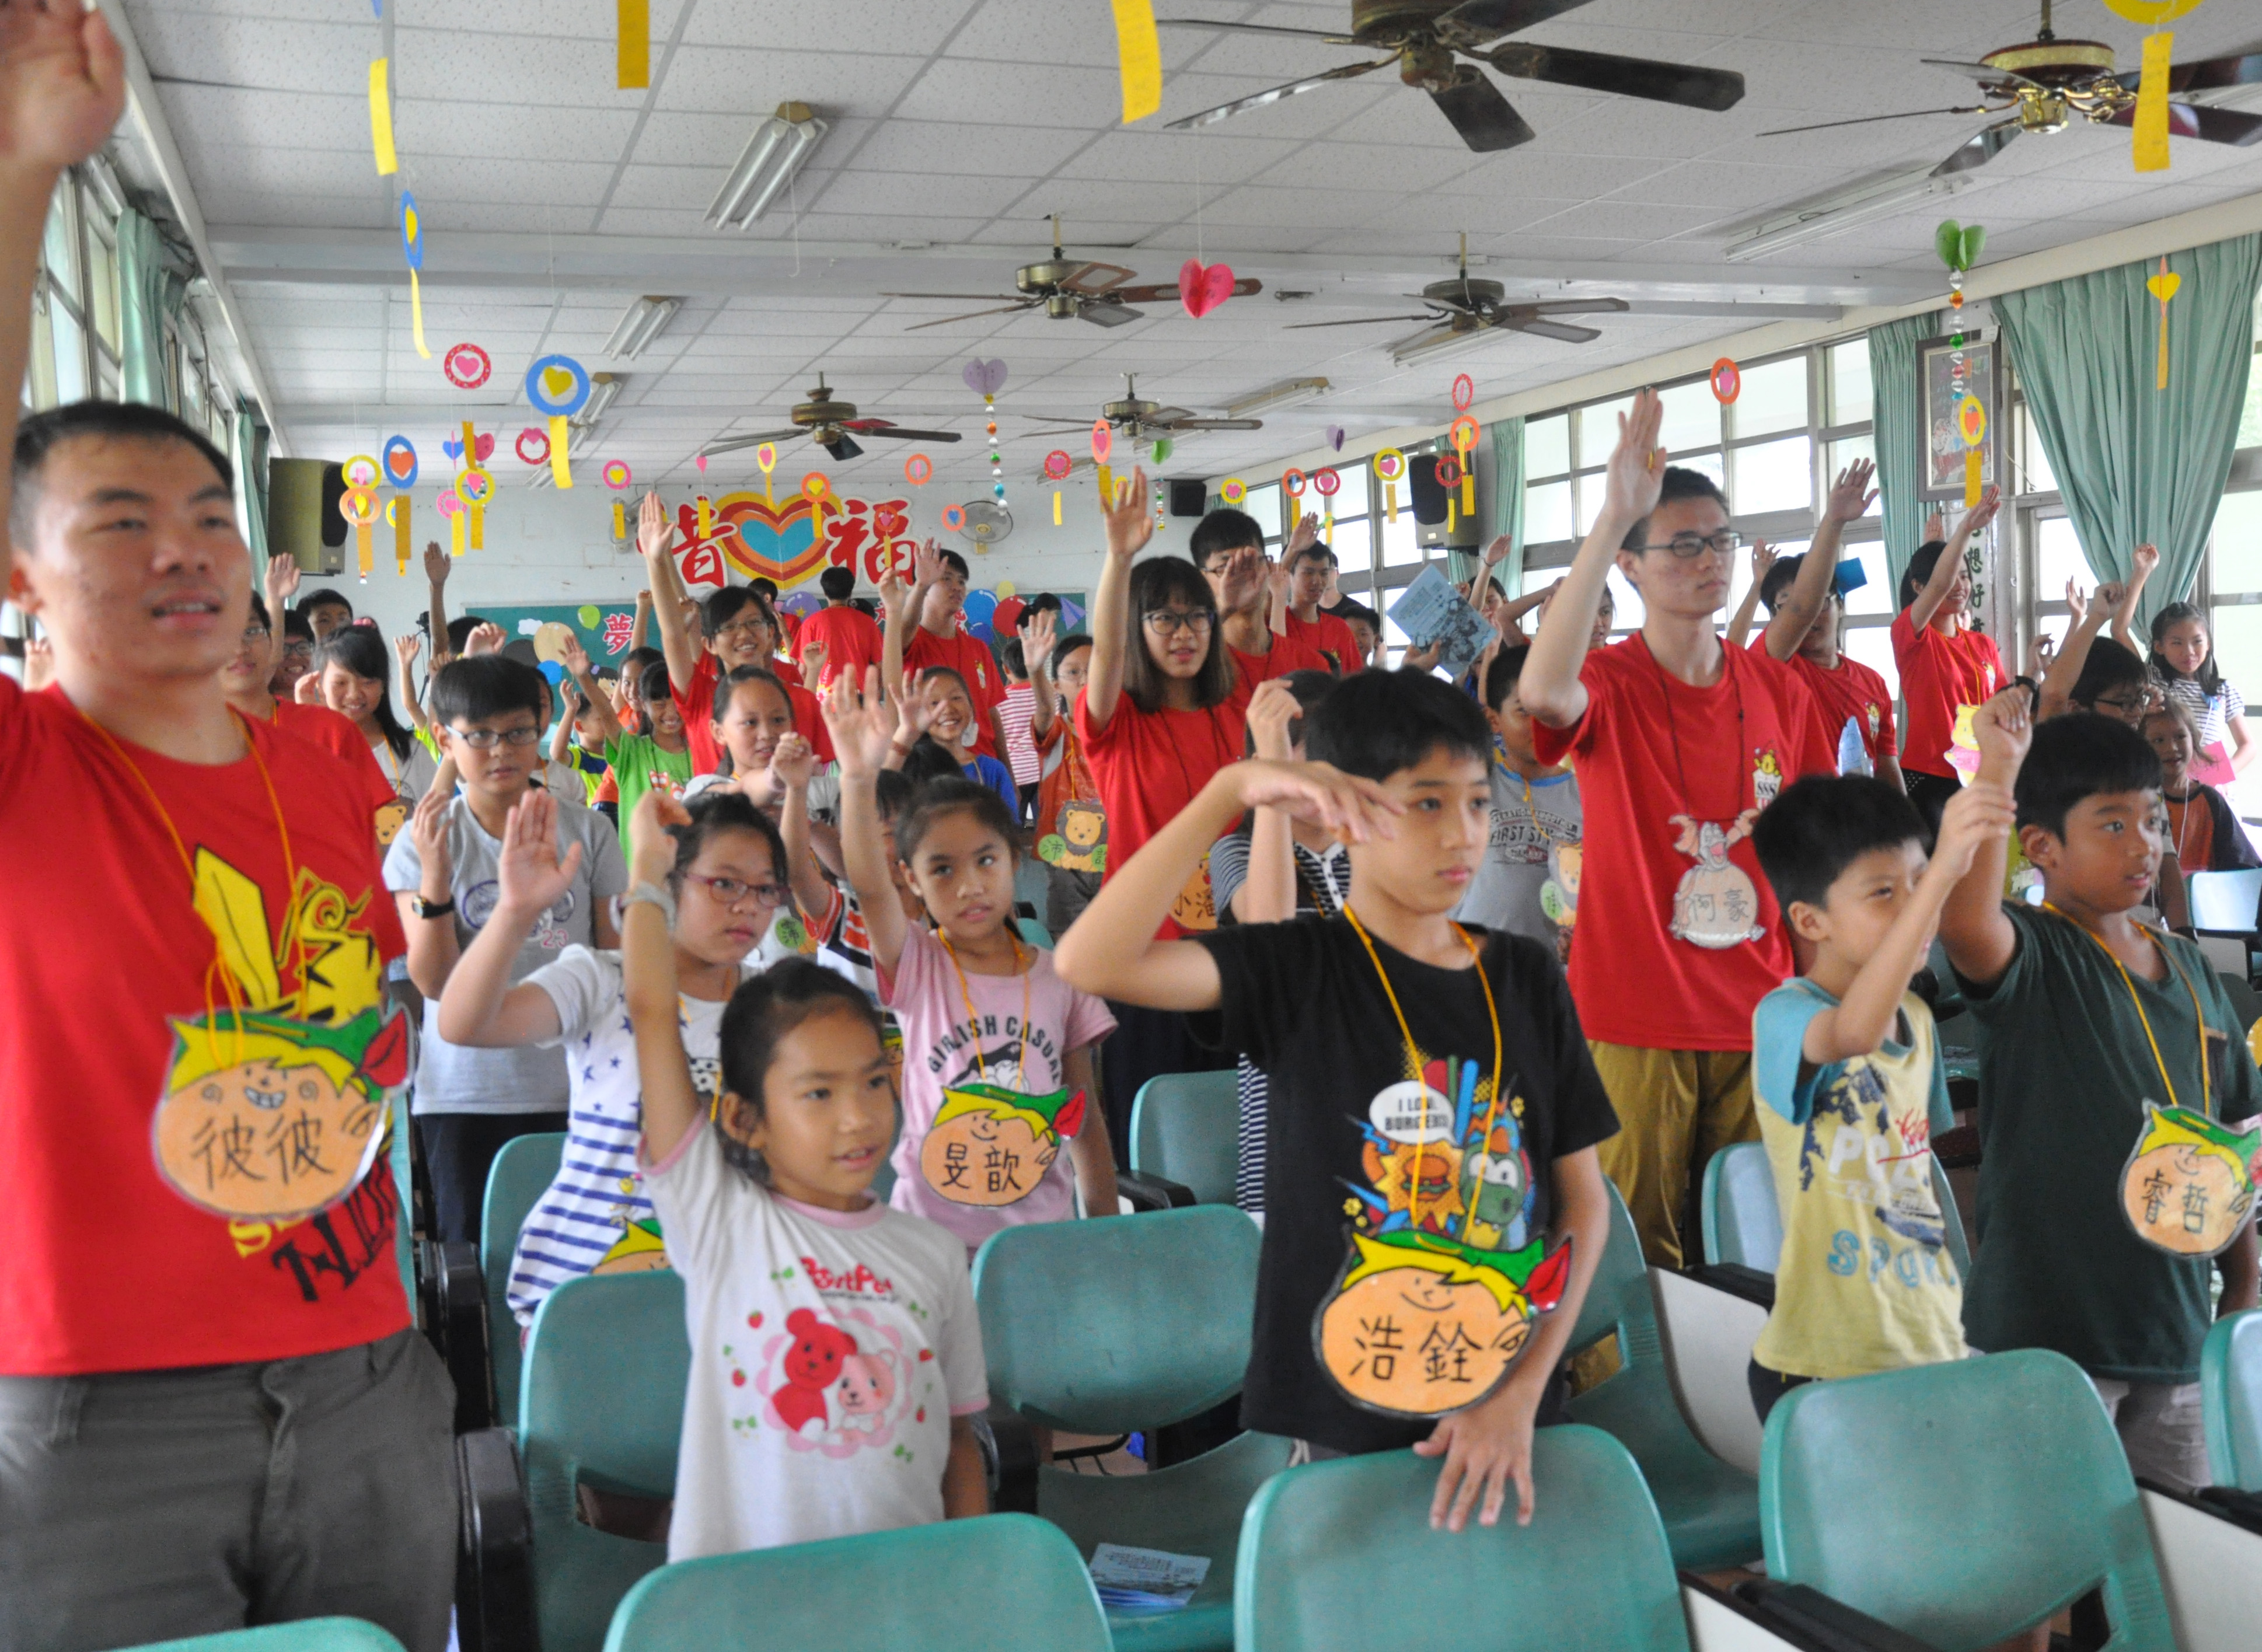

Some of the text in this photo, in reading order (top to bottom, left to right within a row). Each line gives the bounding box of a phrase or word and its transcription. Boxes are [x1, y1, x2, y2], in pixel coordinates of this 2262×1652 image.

[603, 613, 634, 655] 夢
[1490, 826, 1525, 843] FIRST
[191, 1108, 334, 1191] 彼彼
[1349, 1314, 1483, 1384] 浩銓
